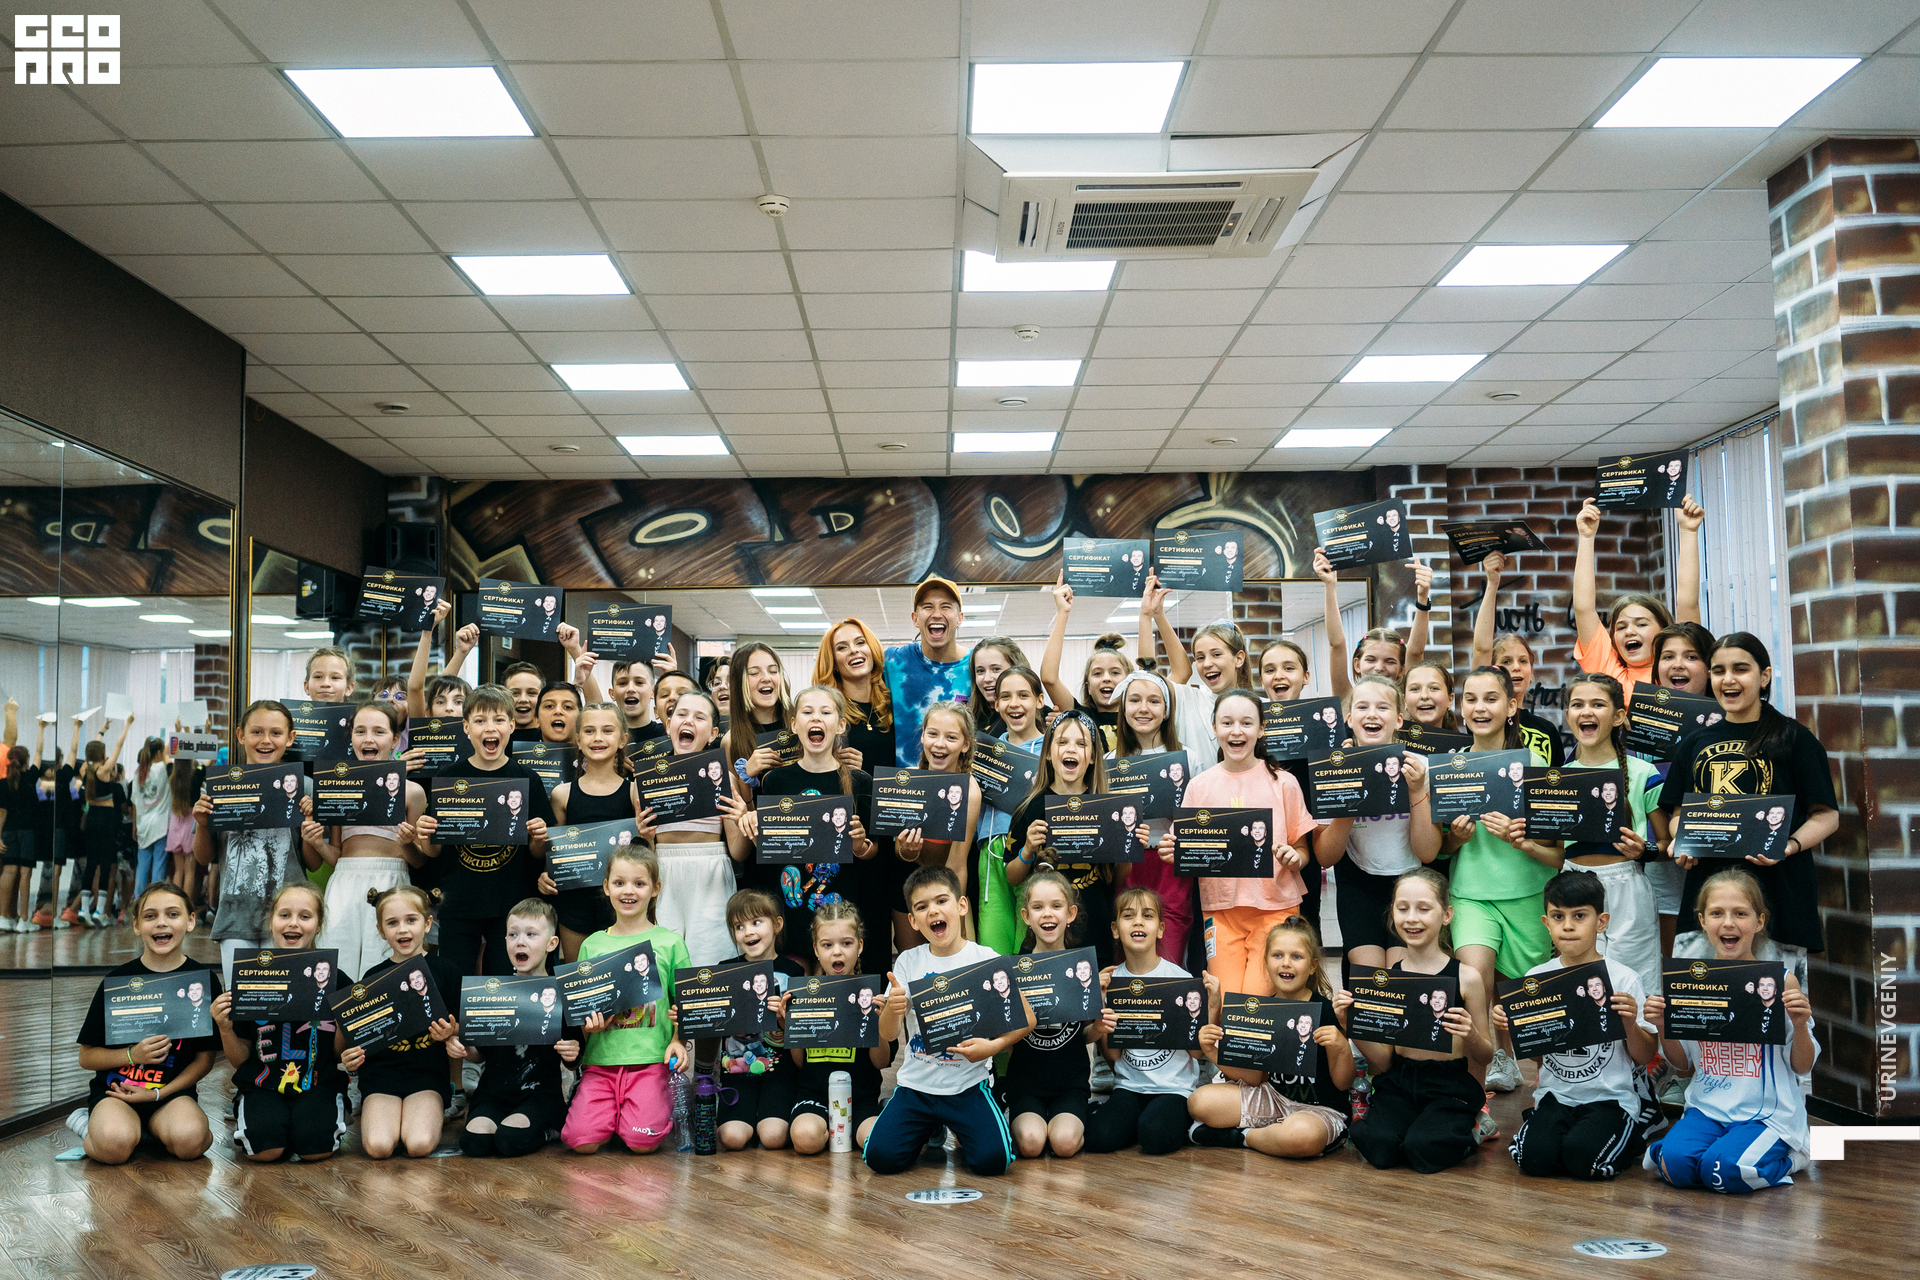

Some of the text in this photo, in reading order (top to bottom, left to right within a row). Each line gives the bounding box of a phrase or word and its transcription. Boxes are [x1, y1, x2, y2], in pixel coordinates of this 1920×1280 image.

[1601, 469, 1646, 477] СЕРТИФИКАТ
[1322, 522, 1366, 535] СЕРТИФИКАТ
[366, 582, 406, 592] СЕРТИФИКАТ
[484, 595, 524, 604] СЕРТИФИКАТ
[1635, 702, 1683, 718] СЕРТИФИКАТ
[974, 751, 1014, 772] СЕРТИФИКАТ
[1315, 768, 1362, 777] СЕРТИФИКАТ
[1435, 772, 1484, 780] СЕРТИФИКАТ
[1709, 760, 1748, 794] K
[642, 774, 687, 786] СЕРТИФИКАТ
[1107, 774, 1148, 783] ЕРТИФИКАТ
[878, 787, 926, 796] СЕРТИФИКАТ
[1530, 788, 1578, 796] СЕРТИФИКАТ
[551, 842, 596, 852] СЕРТИФИКАТ
[564, 972, 612, 989] СЕРТИФИКАТ
[681, 986, 730, 996] СЕРТИФИКАТ
[1670, 983, 1729, 991] СЕРТИФИКАТ
[111, 993, 163, 1002] СЕРТИФИКАТ
[1355, 987, 1406, 1000] СЕРТИФИКАТ
[920, 989, 970, 1009] СЕРТИФИКАТ
[1509, 994, 1562, 1011] СЕРТИФИКАТ
[341, 993, 388, 1018] СЕРТИФИКАТ
[1227, 1014, 1274, 1025] СЕРТИФИКАТ
[118, 1064, 164, 1082] DANCE
